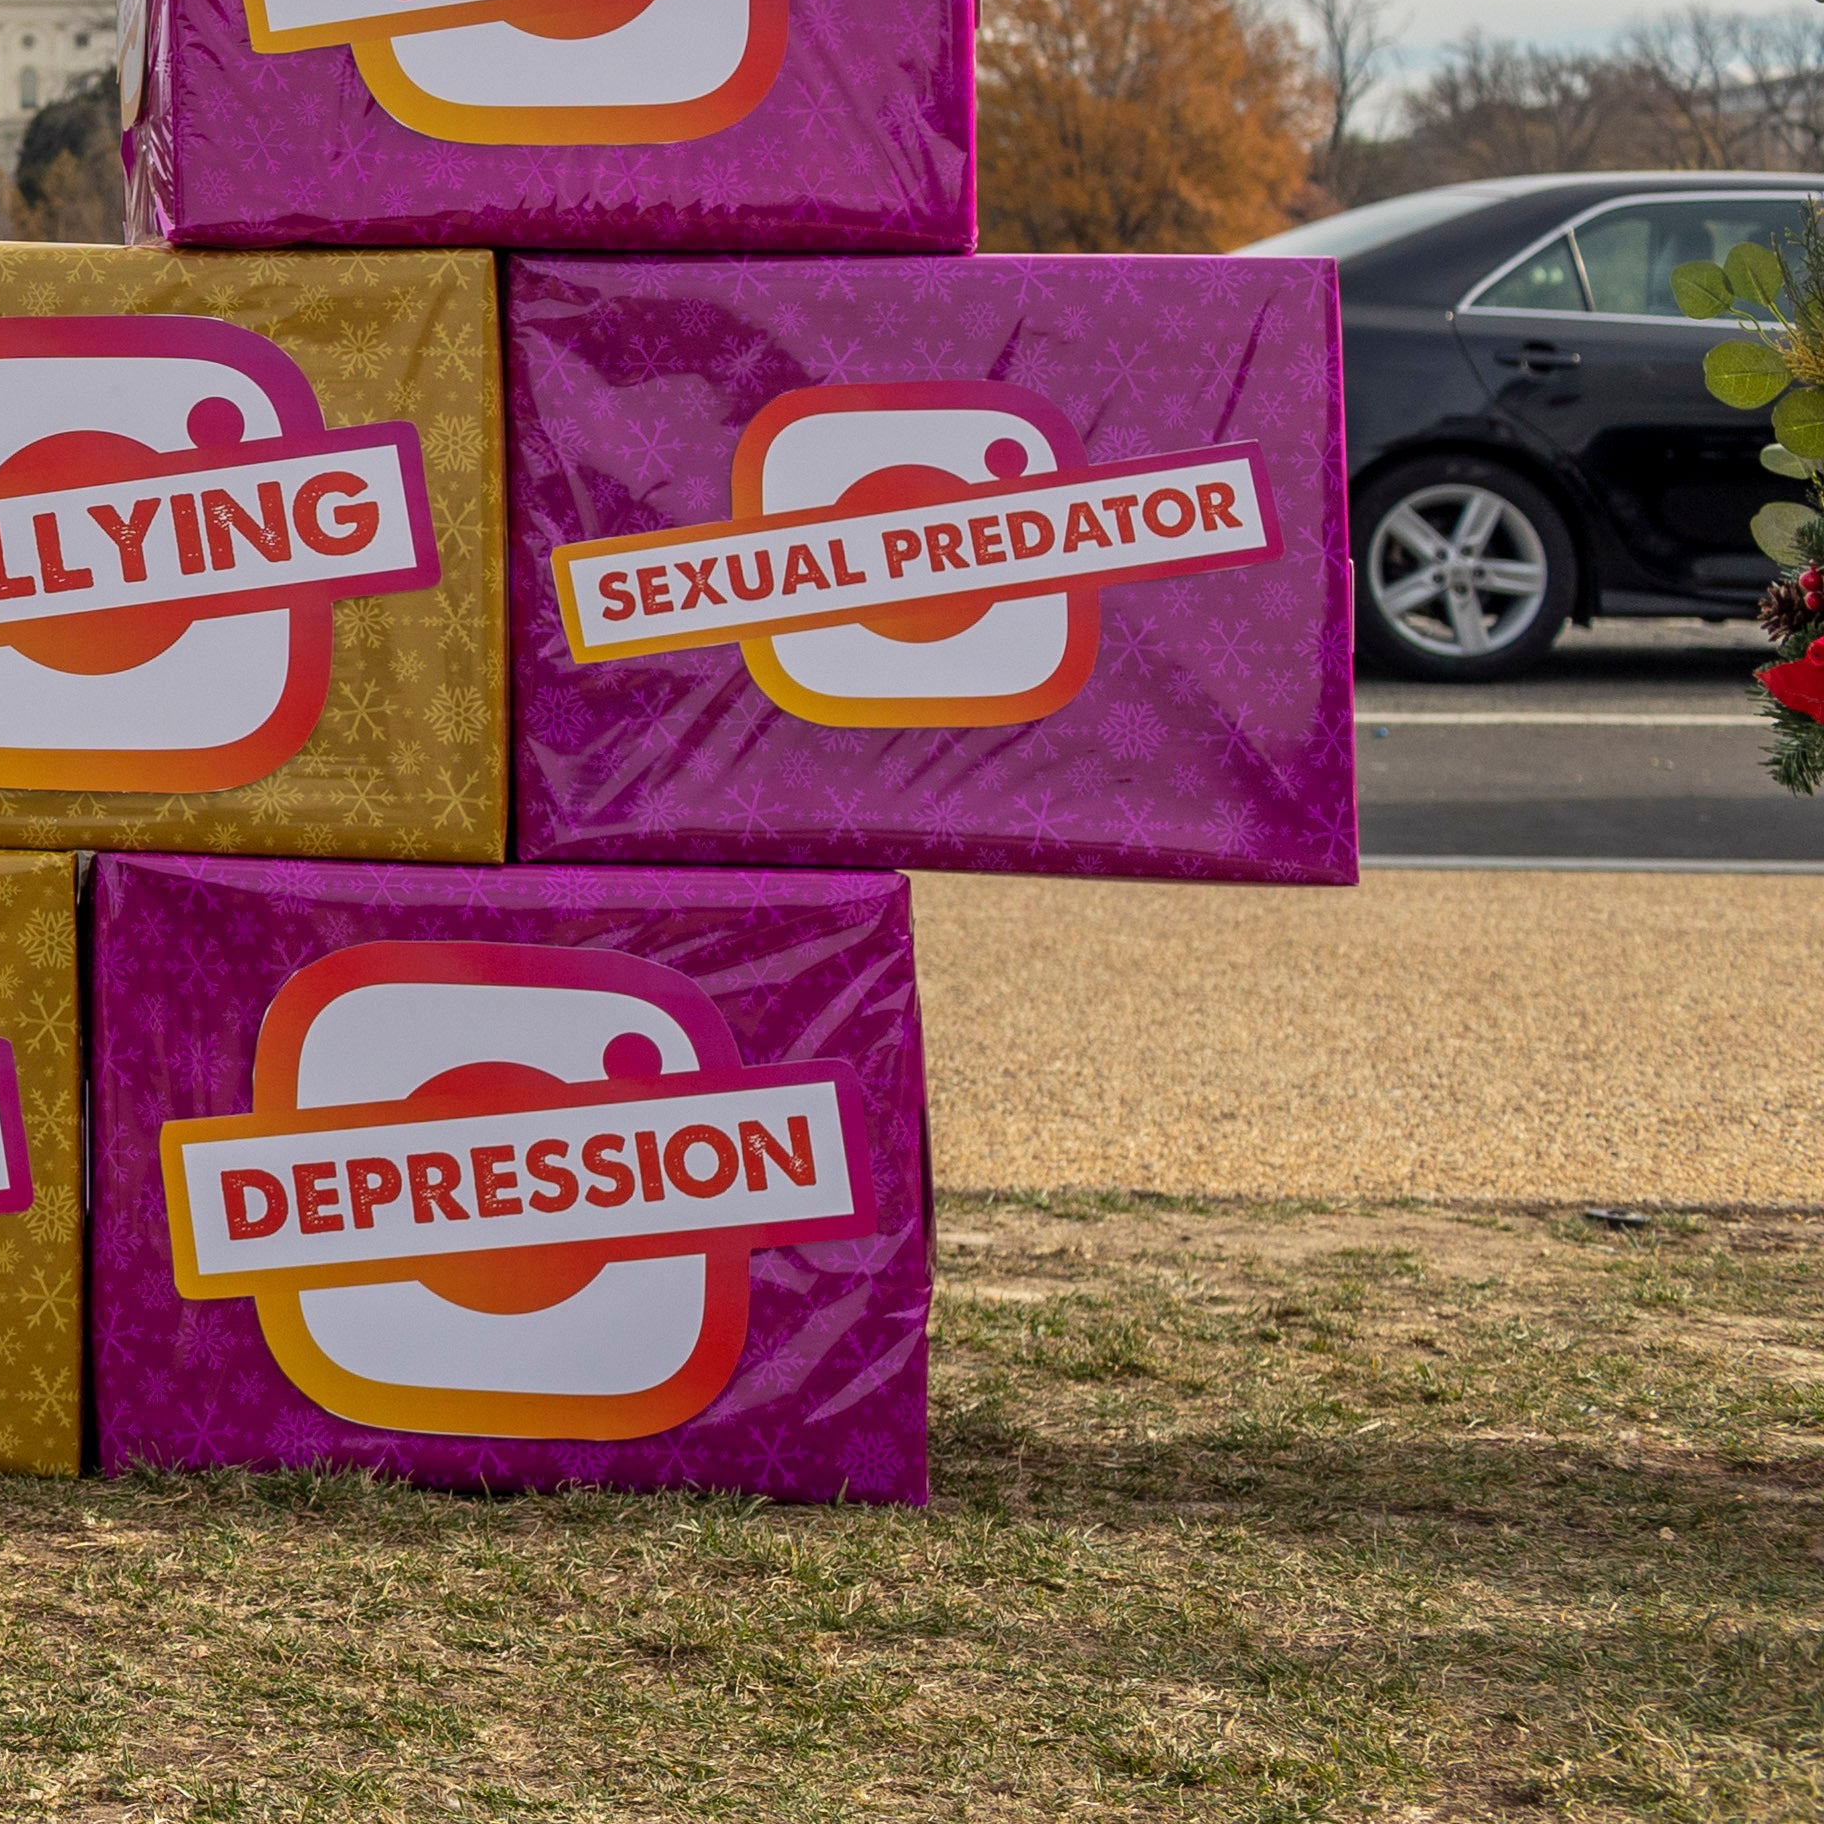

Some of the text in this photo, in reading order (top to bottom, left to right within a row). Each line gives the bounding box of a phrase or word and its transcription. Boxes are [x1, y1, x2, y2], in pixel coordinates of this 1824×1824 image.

[600, 484, 1240, 619] SEXUAL PREDATOR
[222, 1117, 815, 1239] DEPRESSION
